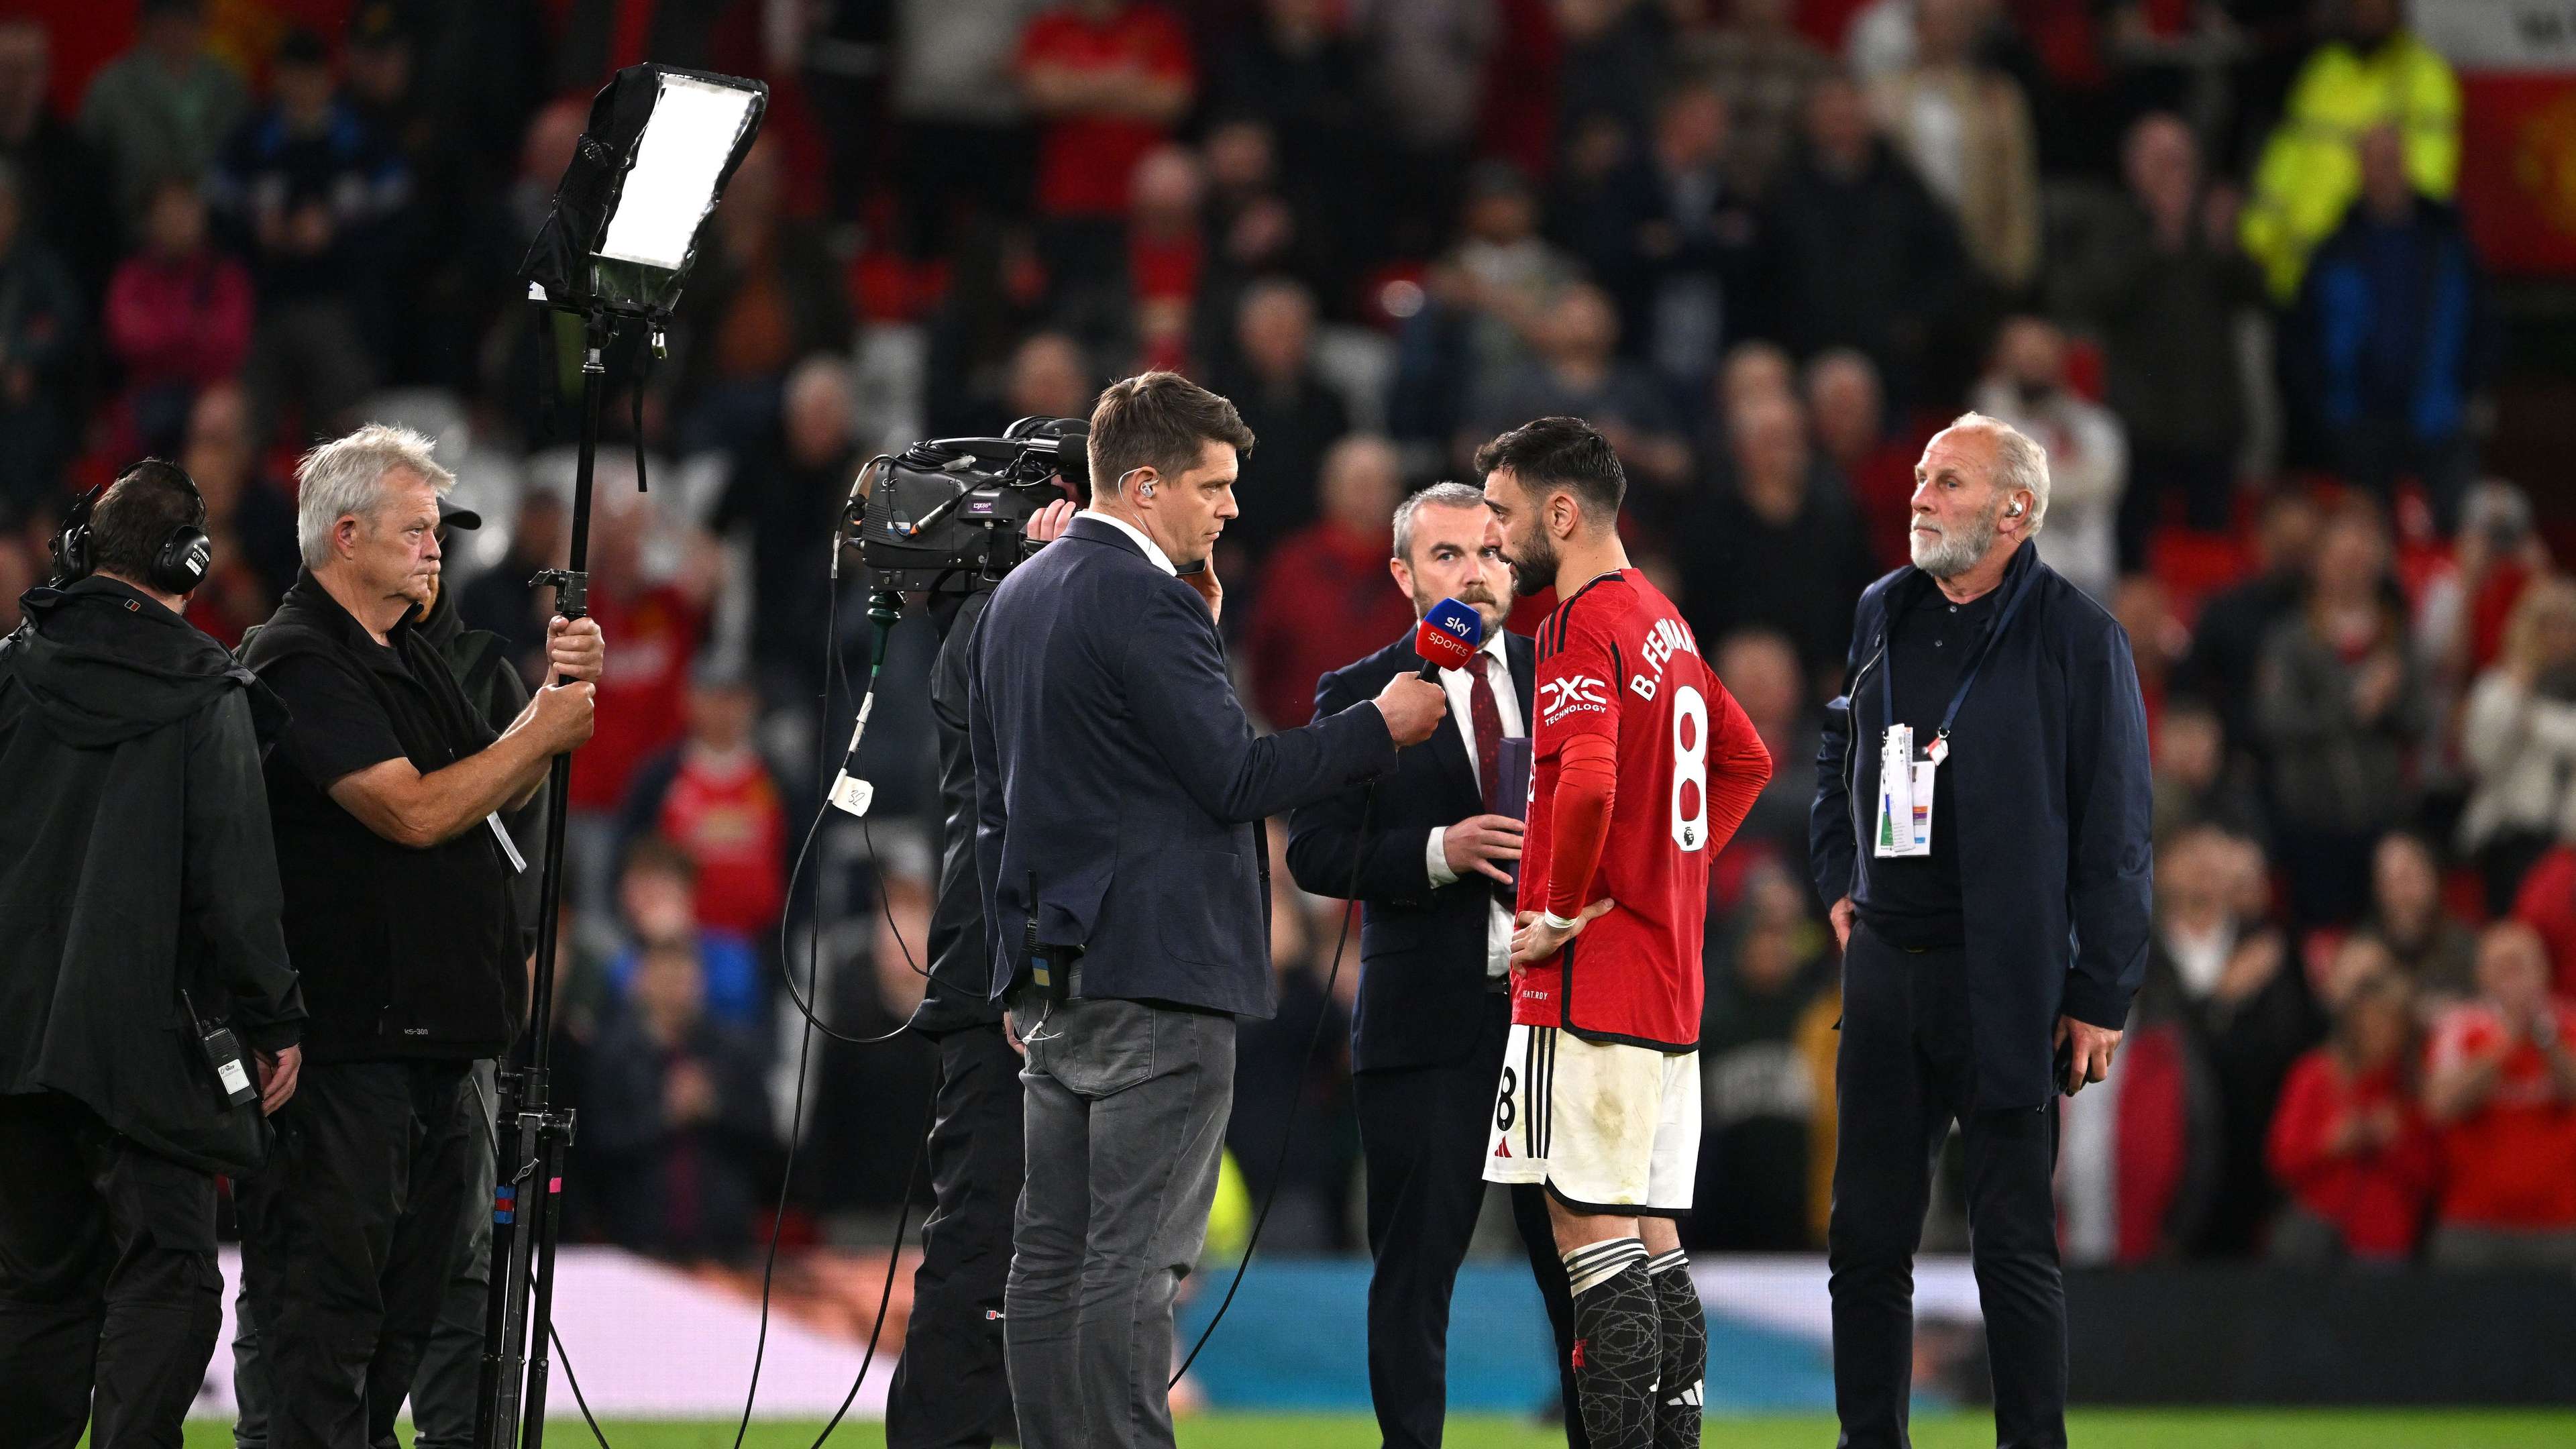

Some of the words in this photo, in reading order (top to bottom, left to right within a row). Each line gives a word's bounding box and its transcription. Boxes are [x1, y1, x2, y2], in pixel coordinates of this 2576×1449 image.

[1444, 616, 1471, 637] sky
[1428, 632, 1468, 657] sports
[1540, 675, 1607, 716] DXC
[1545, 704, 1607, 727] TECHNOLOGY
[1672, 686, 1709, 851] 8
[1497, 1066, 1517, 1132] 8
